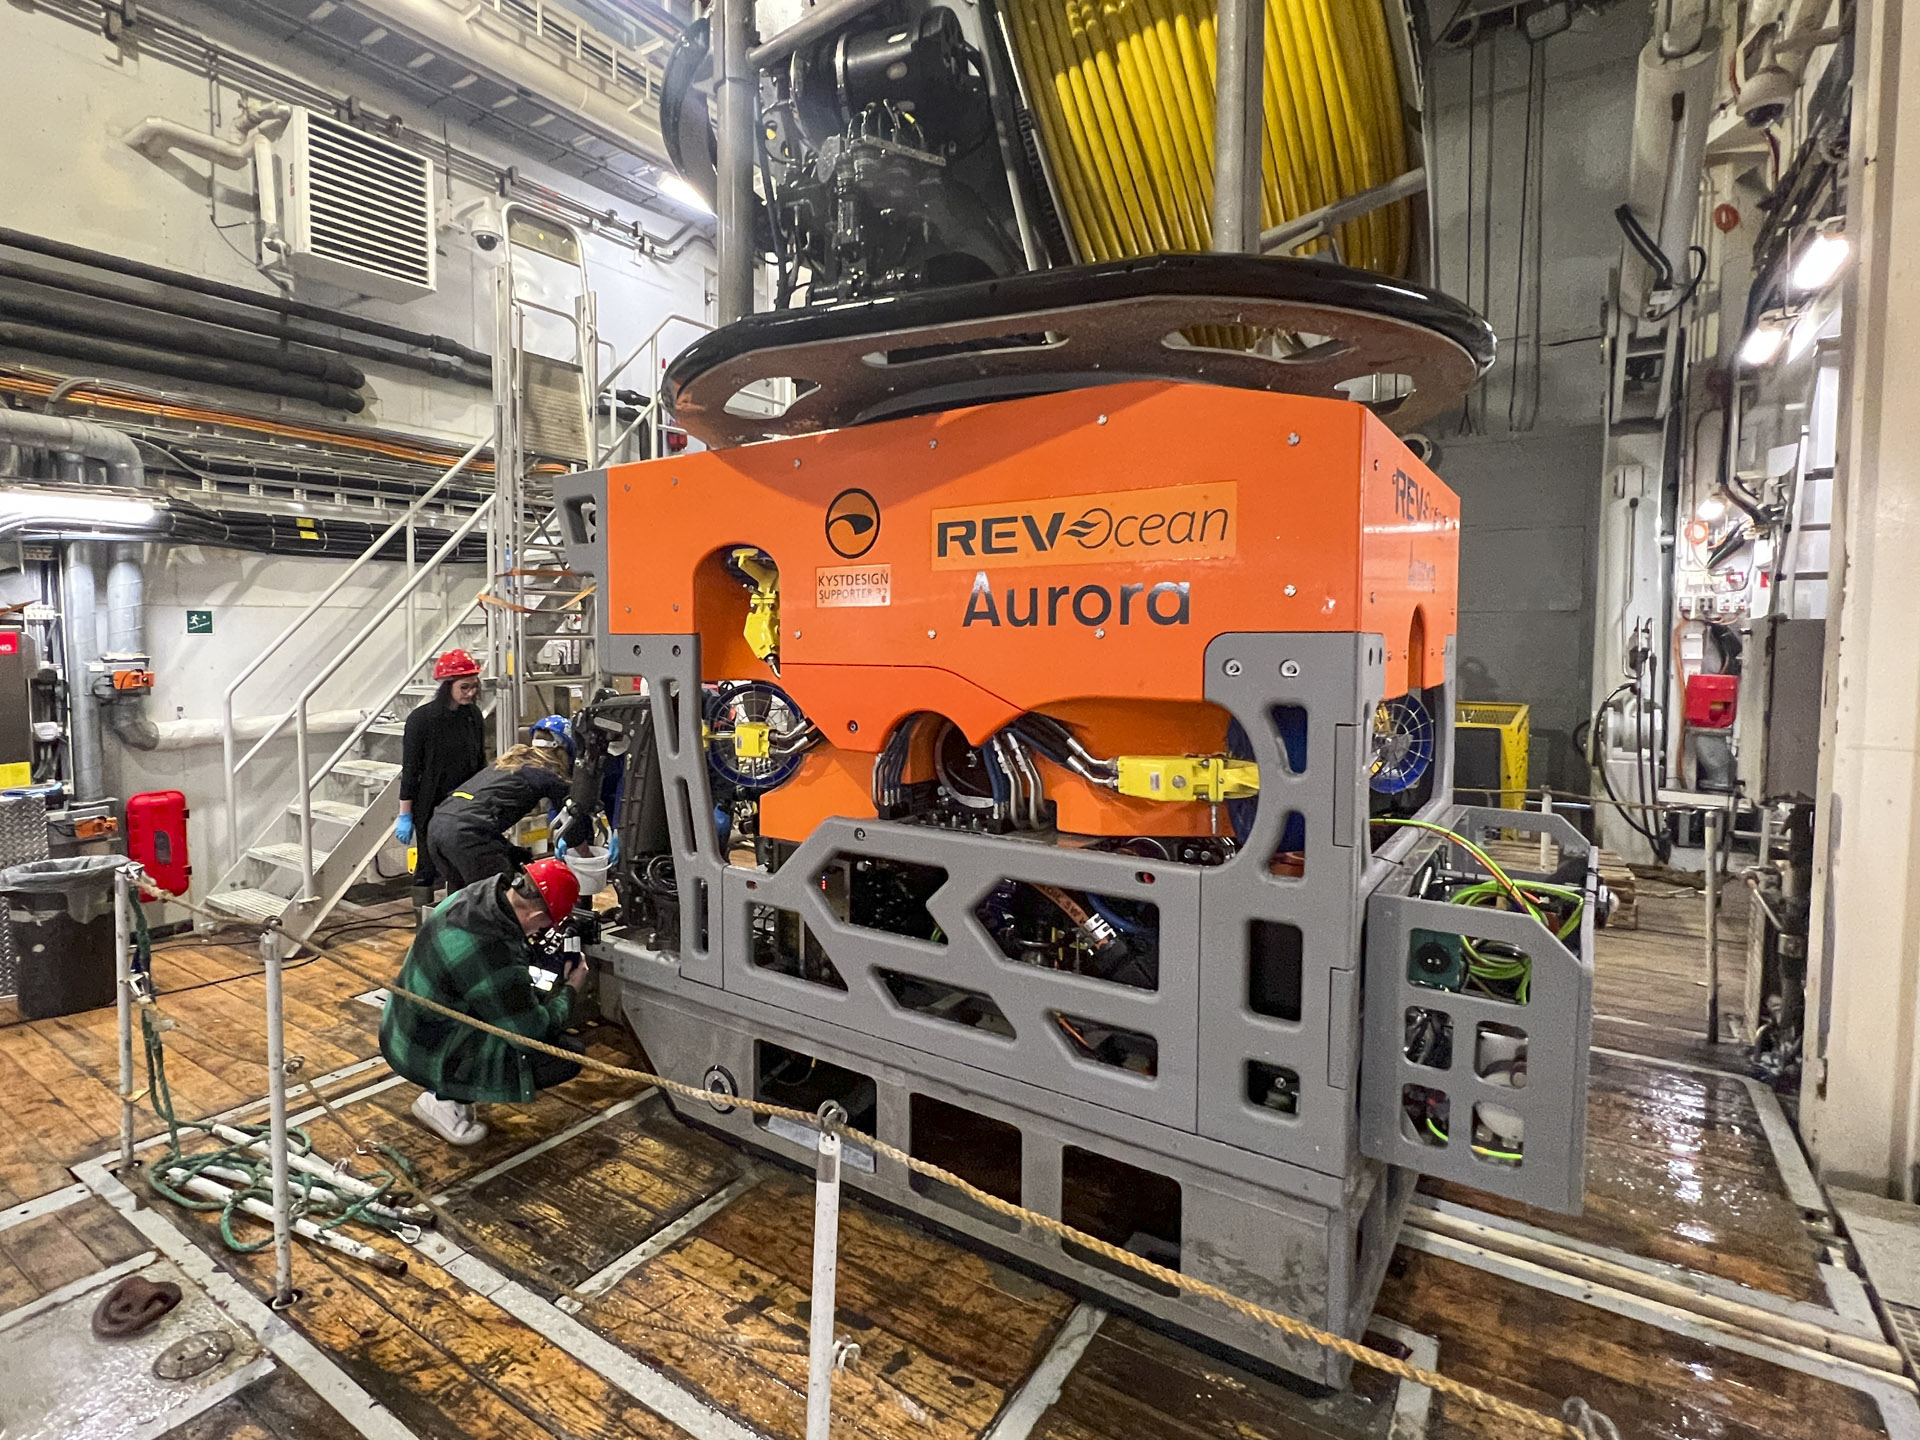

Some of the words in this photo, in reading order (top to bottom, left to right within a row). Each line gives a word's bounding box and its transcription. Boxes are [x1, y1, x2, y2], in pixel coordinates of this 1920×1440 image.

[1395, 467, 1424, 522] REV
[937, 512, 1065, 558] REV
[1077, 507, 1229, 549] Ocean
[818, 573, 888, 587] KYSTDESIGN
[819, 588, 872, 600] SUPPORTER
[962, 571, 1190, 627] Aurora
